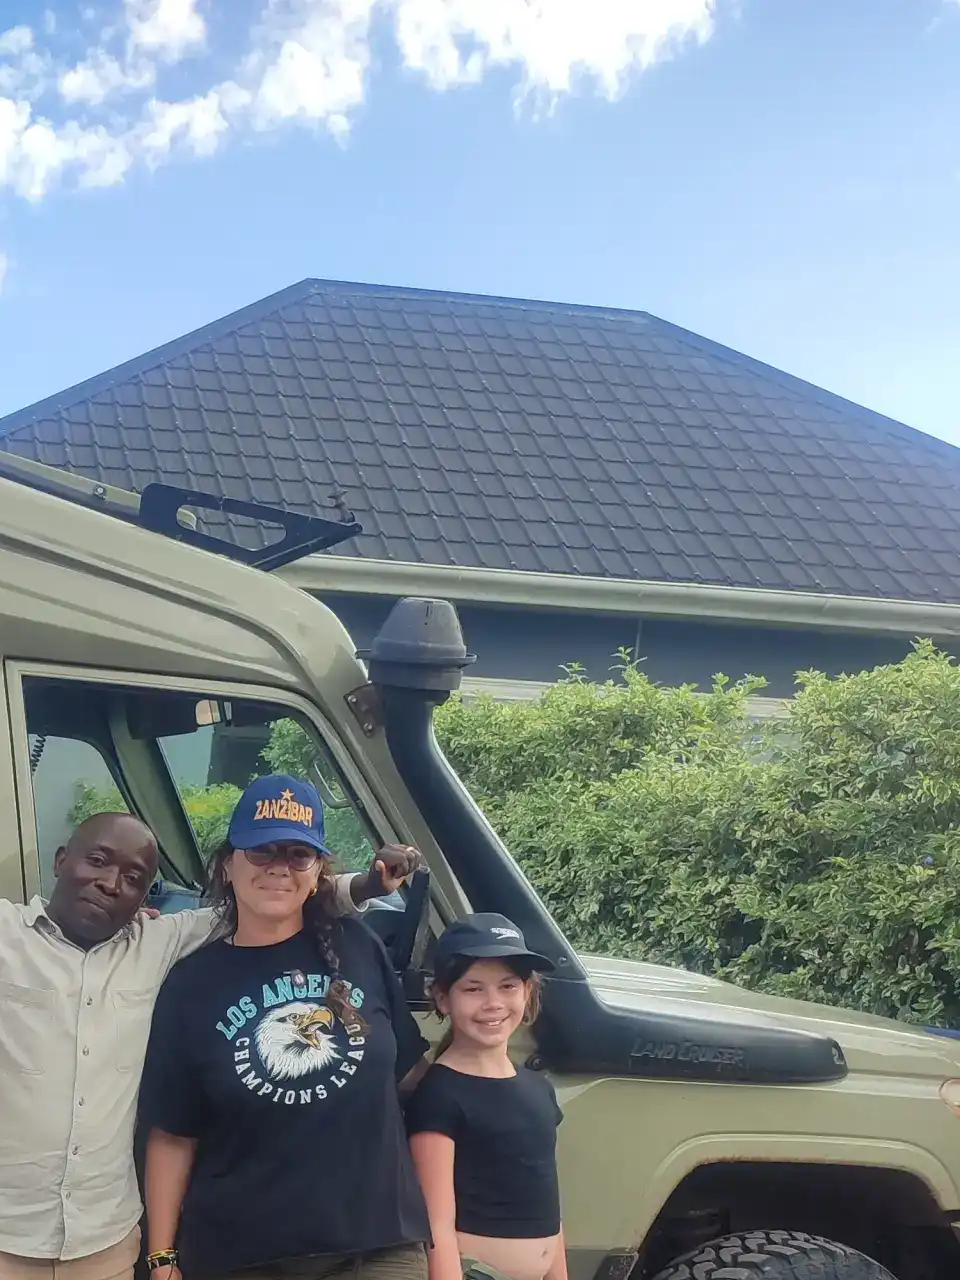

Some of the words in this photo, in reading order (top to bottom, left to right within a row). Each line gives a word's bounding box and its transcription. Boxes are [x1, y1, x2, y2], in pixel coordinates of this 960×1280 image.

[254, 799, 313, 828] ZANZIBAR
[216, 995, 258, 1041] LOS
[630, 1038, 674, 1059] LAND
[676, 1036, 745, 1064] CRUISER
[234, 1037, 328, 1105] CHAMPIONS
